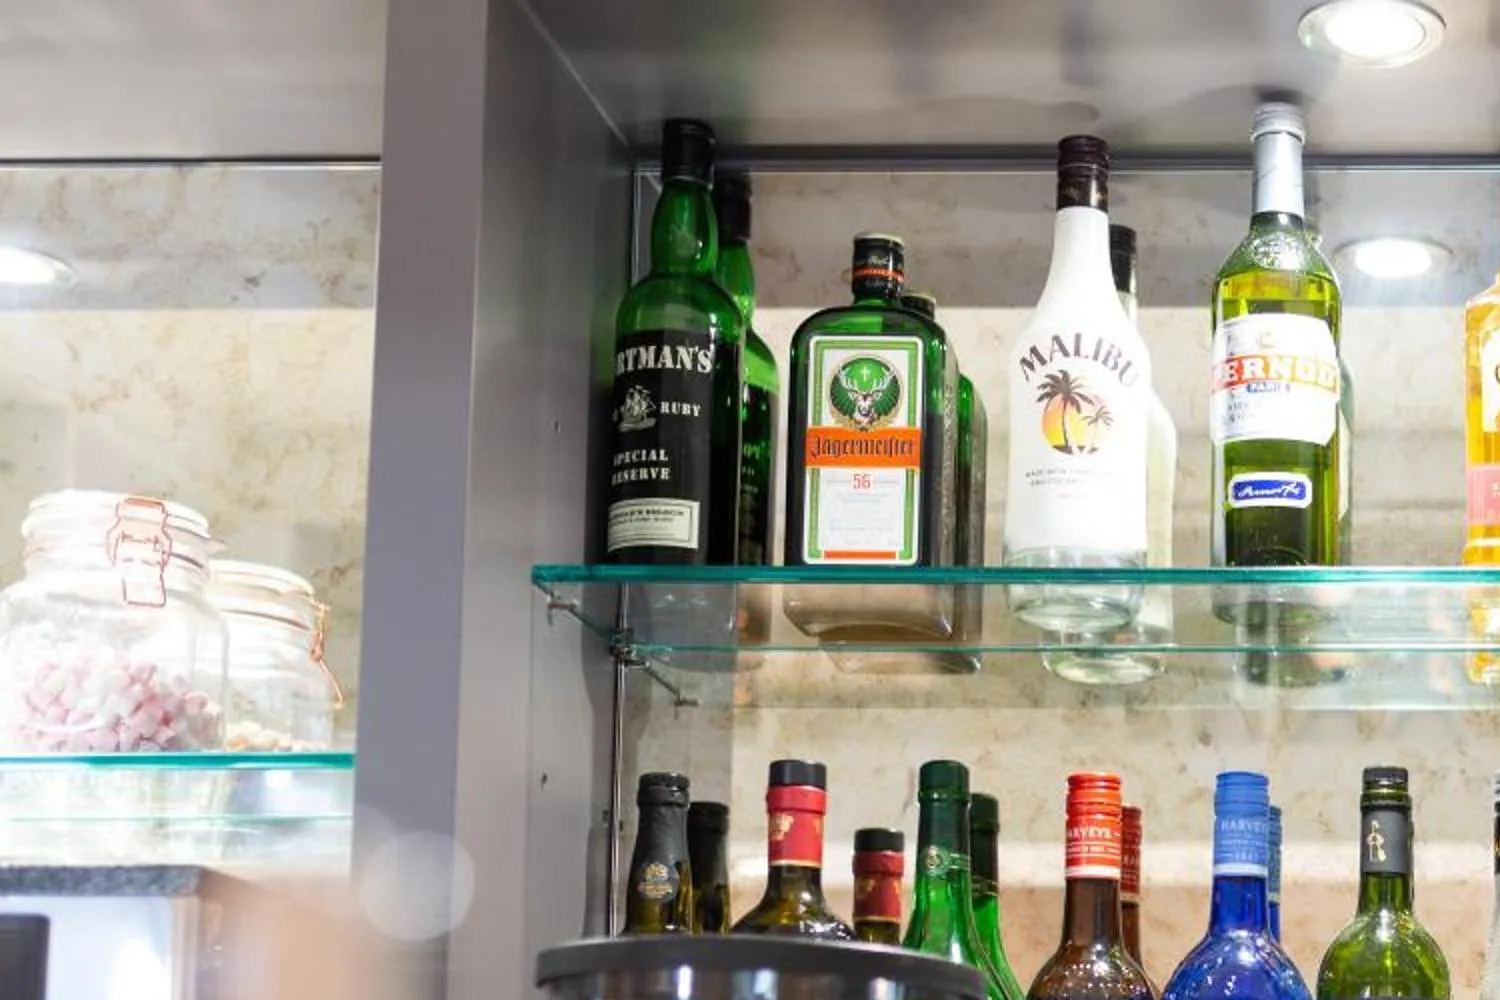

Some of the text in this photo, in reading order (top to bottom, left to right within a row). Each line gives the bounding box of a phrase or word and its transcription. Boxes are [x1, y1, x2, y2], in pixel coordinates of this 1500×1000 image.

[1019, 333, 1139, 387] MALIBU
[1214, 356, 1336, 393] ERNOD
[660, 401, 701, 417] RUBY
[852, 473, 871, 489] 56
